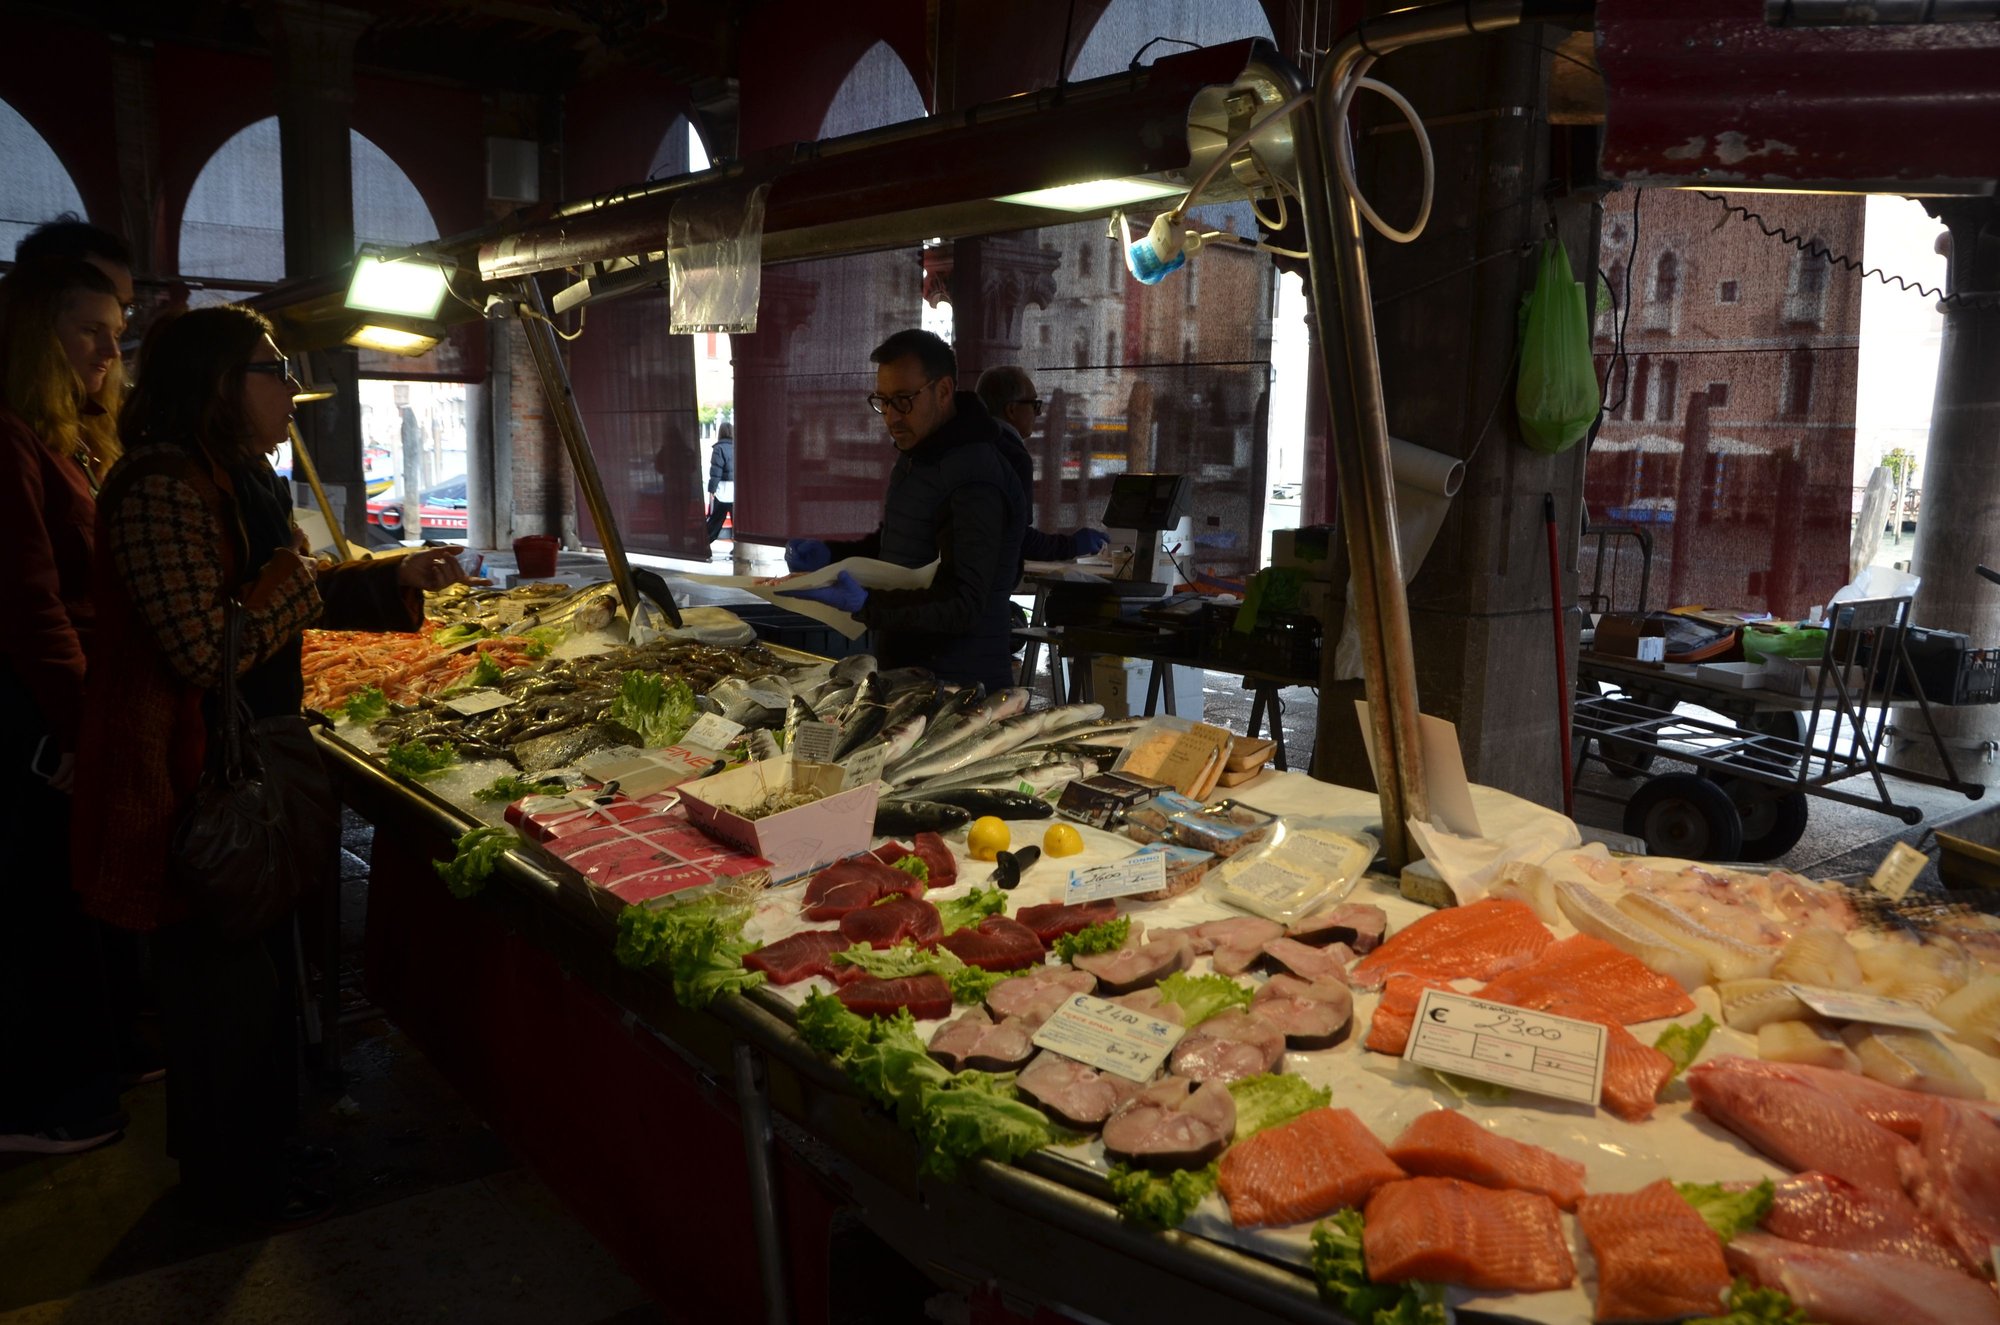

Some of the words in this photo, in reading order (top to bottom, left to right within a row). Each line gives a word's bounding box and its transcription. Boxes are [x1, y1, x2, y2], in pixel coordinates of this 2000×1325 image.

[662, 745, 715, 769] FINE
[1128, 855, 1160, 865] TONNO
[1074, 996, 1088, 1008] €
[1061, 1011, 1087, 1023] PESCE
[1087, 1020, 1114, 1033] SPADA
[1429, 1007, 1450, 1024] €
